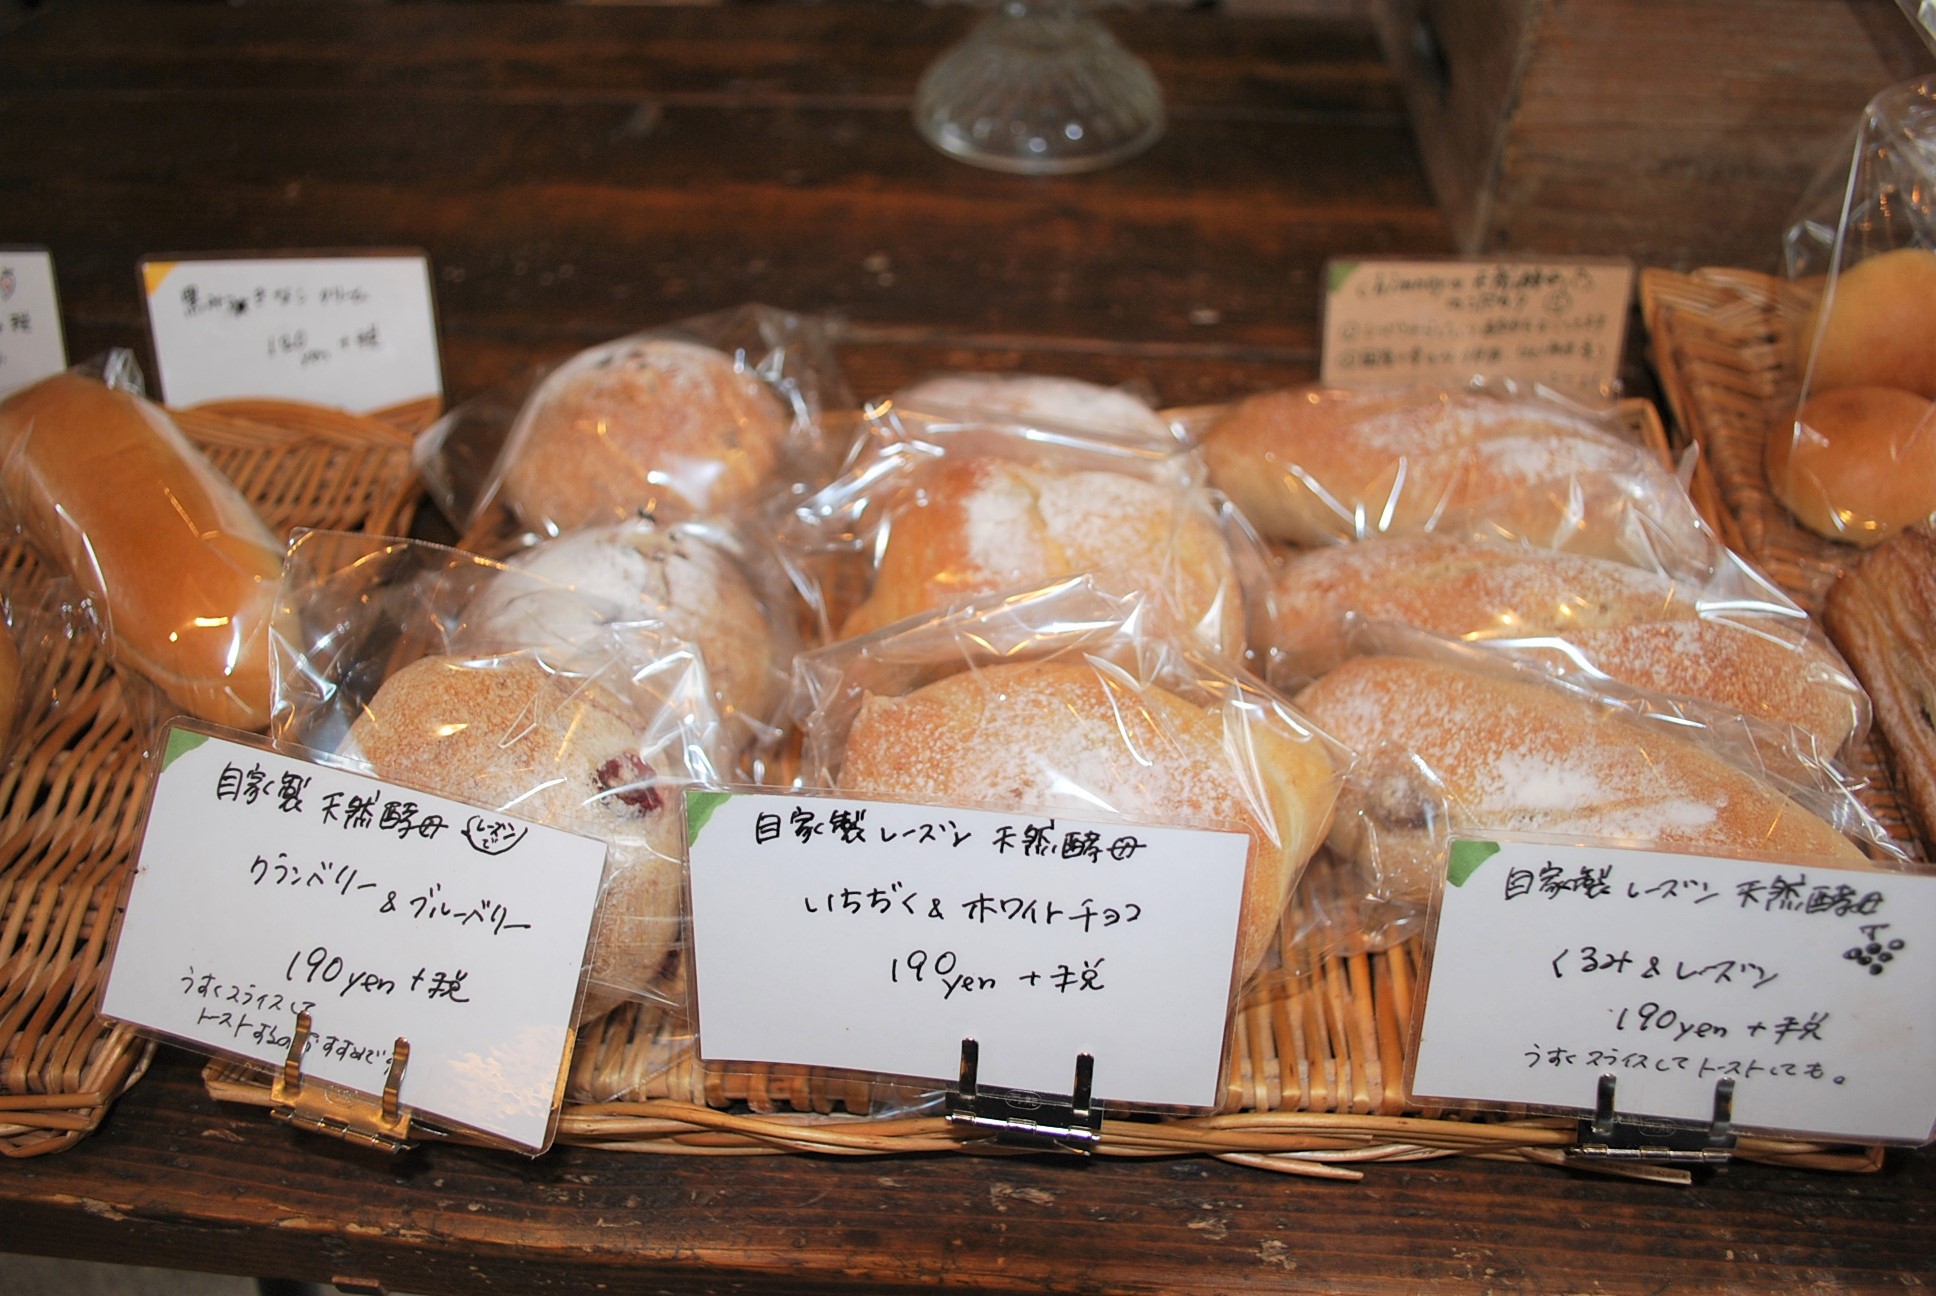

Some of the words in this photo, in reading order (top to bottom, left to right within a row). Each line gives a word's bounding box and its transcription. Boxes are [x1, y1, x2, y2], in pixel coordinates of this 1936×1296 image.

[217, 762, 311, 813] 自家製
[322, 790, 449, 839] 天然酵母
[755, 807, 867, 845] 自家製
[880, 821, 972, 846] レーズン
[992, 819, 1147, 863] 天然酵母
[250, 853, 377, 896] クランベリー
[379, 891, 396, 913] &
[410, 883, 531, 935] ブルーベリー
[805, 882, 917, 915] いちぢく
[927, 898, 944, 919] &
[962, 892, 1142, 932] ホワイトチョコ
[1504, 861, 1613, 900] 自家製
[1627, 879, 1719, 903] レーズン
[1736, 874, 1884, 917] 天然酵母
[1552, 946, 1633, 978] くるみ
[1641, 956, 1661, 979] &
[1676, 960, 1779, 989] レーズン
